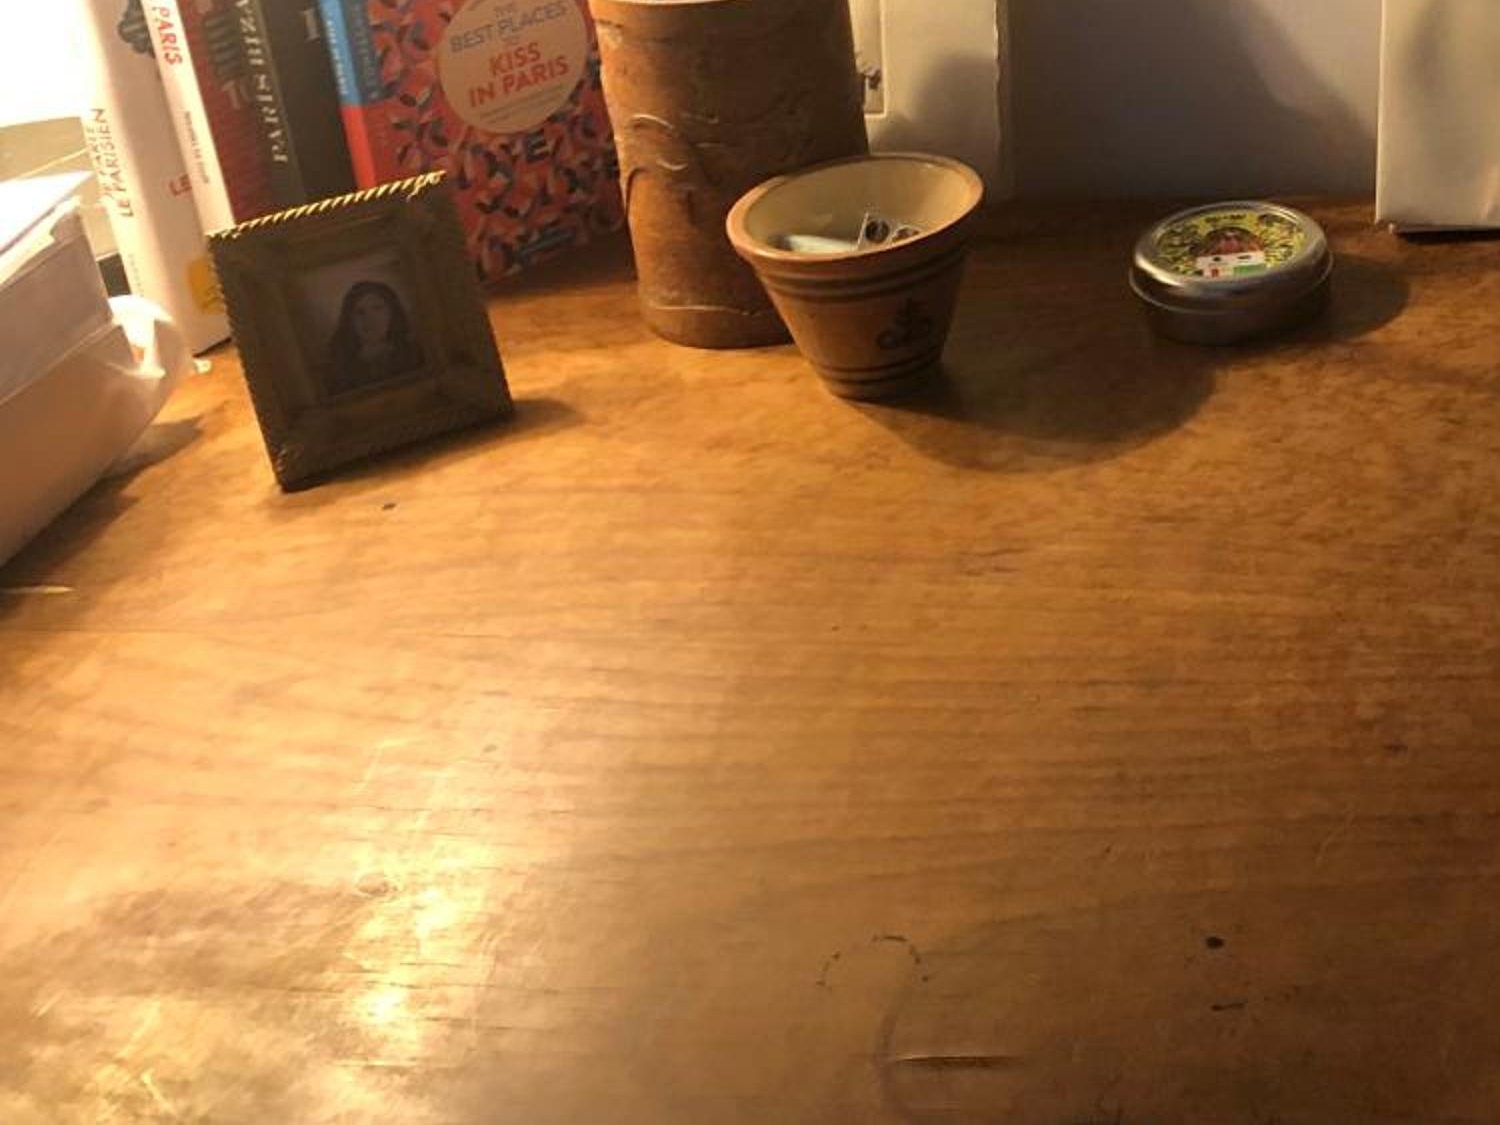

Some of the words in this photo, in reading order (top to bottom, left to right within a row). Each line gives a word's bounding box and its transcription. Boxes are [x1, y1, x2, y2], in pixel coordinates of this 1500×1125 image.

[152, 6, 183, 64] PARIS
[451, 25, 494, 52] BEST
[499, 2, 566, 32] PLACES
[469, 81, 495, 107] IN
[501, 55, 569, 95] PARIS
[489, 42, 541, 75] KISS
[253, 74, 288, 163] PARIS
